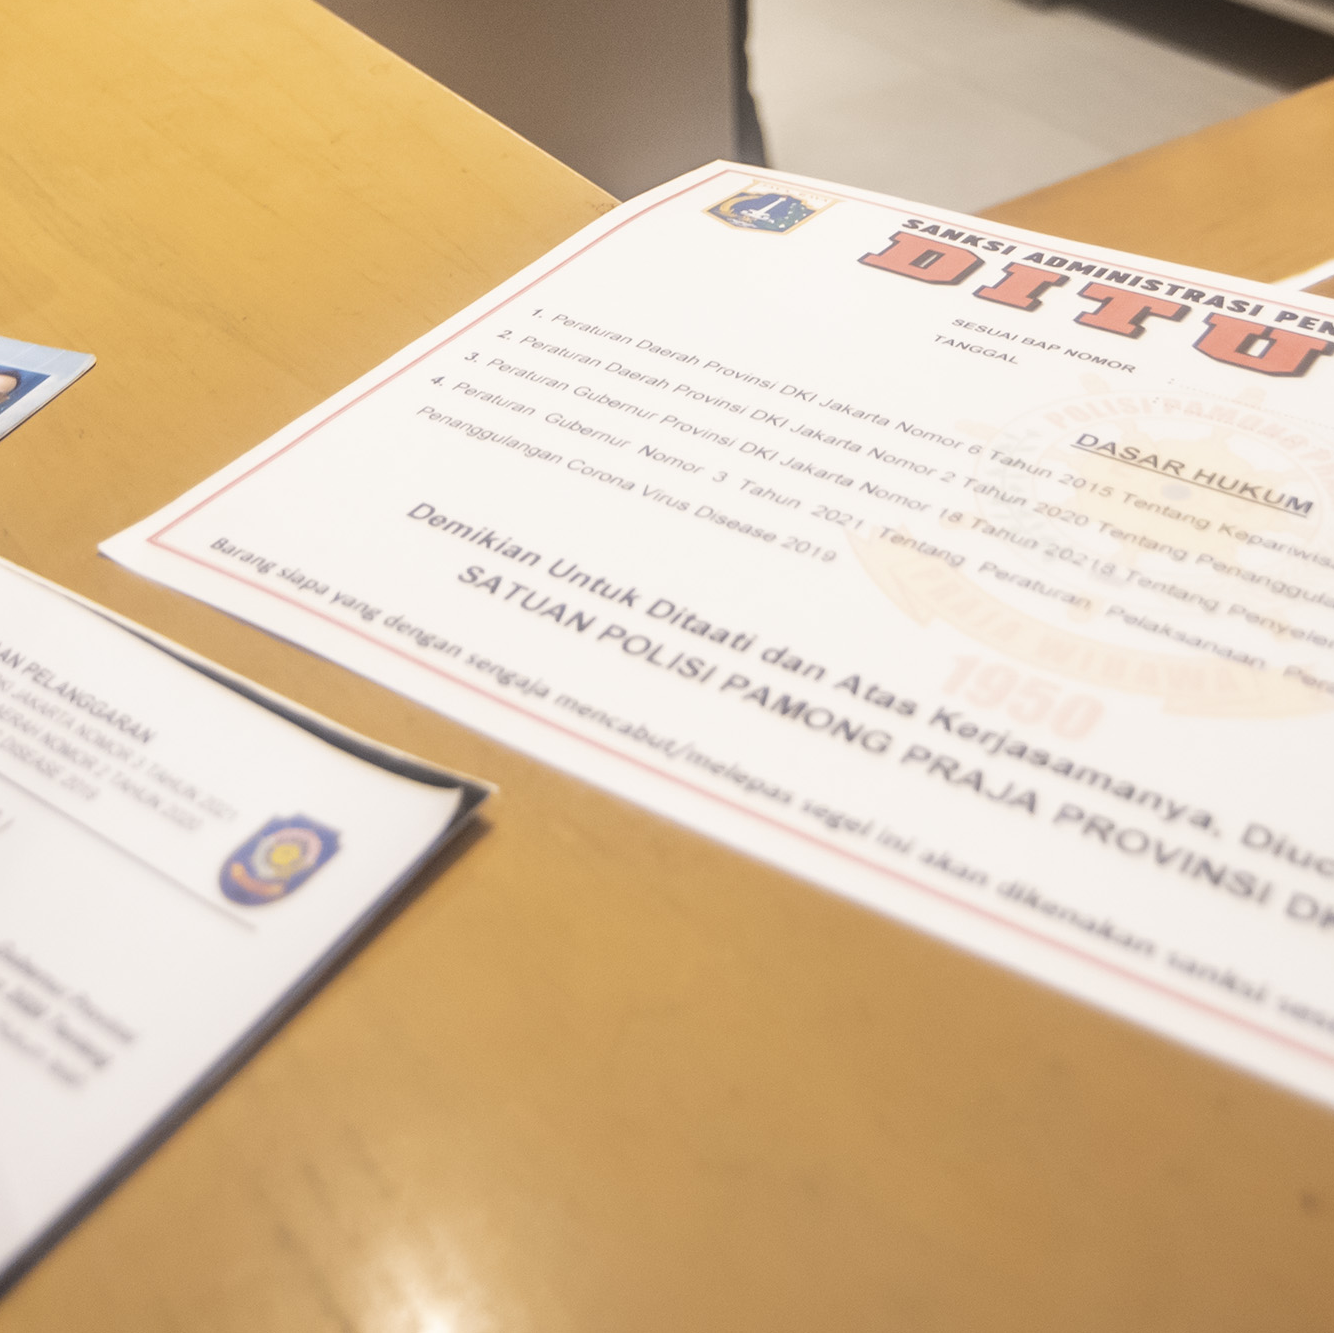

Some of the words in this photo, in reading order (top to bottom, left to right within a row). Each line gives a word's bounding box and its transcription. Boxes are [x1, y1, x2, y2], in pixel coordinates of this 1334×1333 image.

[902, 218, 1017, 256] SANKSI
[1022, 252, 1264, 317] ADMINISTRASI
[933, 334, 1019, 365] TANGGAL
[951, 318, 1019, 343] SESUAI
[1022, 337, 1062, 353] BAP
[1063, 349, 1137, 374] NOMOR
[417, 406, 563, 464] Penanggulangan
[567, 459, 635, 491] Corona
[641, 484, 690, 512] Virus
[694, 505, 777, 543] Disease
[781, 536, 837, 563] 2019
[486, 358, 569, 391] Peraturan
[573, 386, 659, 420] Gubernur
[659, 414, 737, 448] Provinsi
[739, 441, 779, 461] DKI
[780, 457, 854, 488] Jakarta
[859, 481, 931, 513] Nomor
[939, 508, 963, 524] 18
[970, 516, 1039, 549] Tahun
[1125, 568, 1220, 612] Tentang
[519, 335, 602, 367] Peraturan
[605, 362, 669, 390] Daerah
[673, 384, 750, 415] Provinsi
[750, 409, 789, 428] DKI
[790, 424, 862, 453] Jakarta
[867, 447, 937, 476] Nomor
[940, 471, 957, 483] 2
[962, 477, 1027, 506] Tahun
[1032, 501, 1089, 526] 2020
[1098, 521, 1188, 562] Tentang
[551, 313, 633, 344] Peraturan
[636, 339, 700, 366] Daerah
[703, 360, 776, 390] Provinsi
[779, 384, 818, 403] DKI
[819, 398, 890, 426] Jakarta
[894, 421, 964, 449] Nomor
[968, 444, 983, 455] 6
[989, 449, 1053, 479] Tahun
[1058, 473, 1115, 498] 2015
[1122, 491, 1211, 531] Tentang
[1074, 433, 1185, 476] DASAR
[1192, 468, 1315, 515] HUKUM
[452, 381, 536, 416] Peraturan
[544, 412, 631, 448] Gubernur
[637, 444, 705, 475] Nomor
[712, 471, 728, 483] 3
[739, 478, 801, 509] Tahun
[811, 504, 864, 529] 2021
[879, 526, 966, 568] Tentang
[977, 561, 1092, 609] Peraturan
[1105, 605, 1267, 670] Pelaksanaan
[209, 536, 277, 575] Barang
[277, 567, 330, 597] siapa
[331, 590, 382, 622] yang
[383, 613, 462, 658] dengan
[465, 652, 551, 700] sengaja
[406, 502, 542, 567] Demikian
[547, 558, 640, 608] Untuk
[646, 598, 757, 653] Ditaati
[761, 644, 827, 682] dan
[834, 673, 919, 718] Atas
[21, 660, 158, 744] PELANGGARAN
[457, 564, 595, 633] SATUAN
[598, 623, 717, 684] POLISI
[720, 673, 892, 755] PAMONG
[900, 742, 1039, 816] PRAJA
[1054, 802, 1273, 905] PROVINSI
